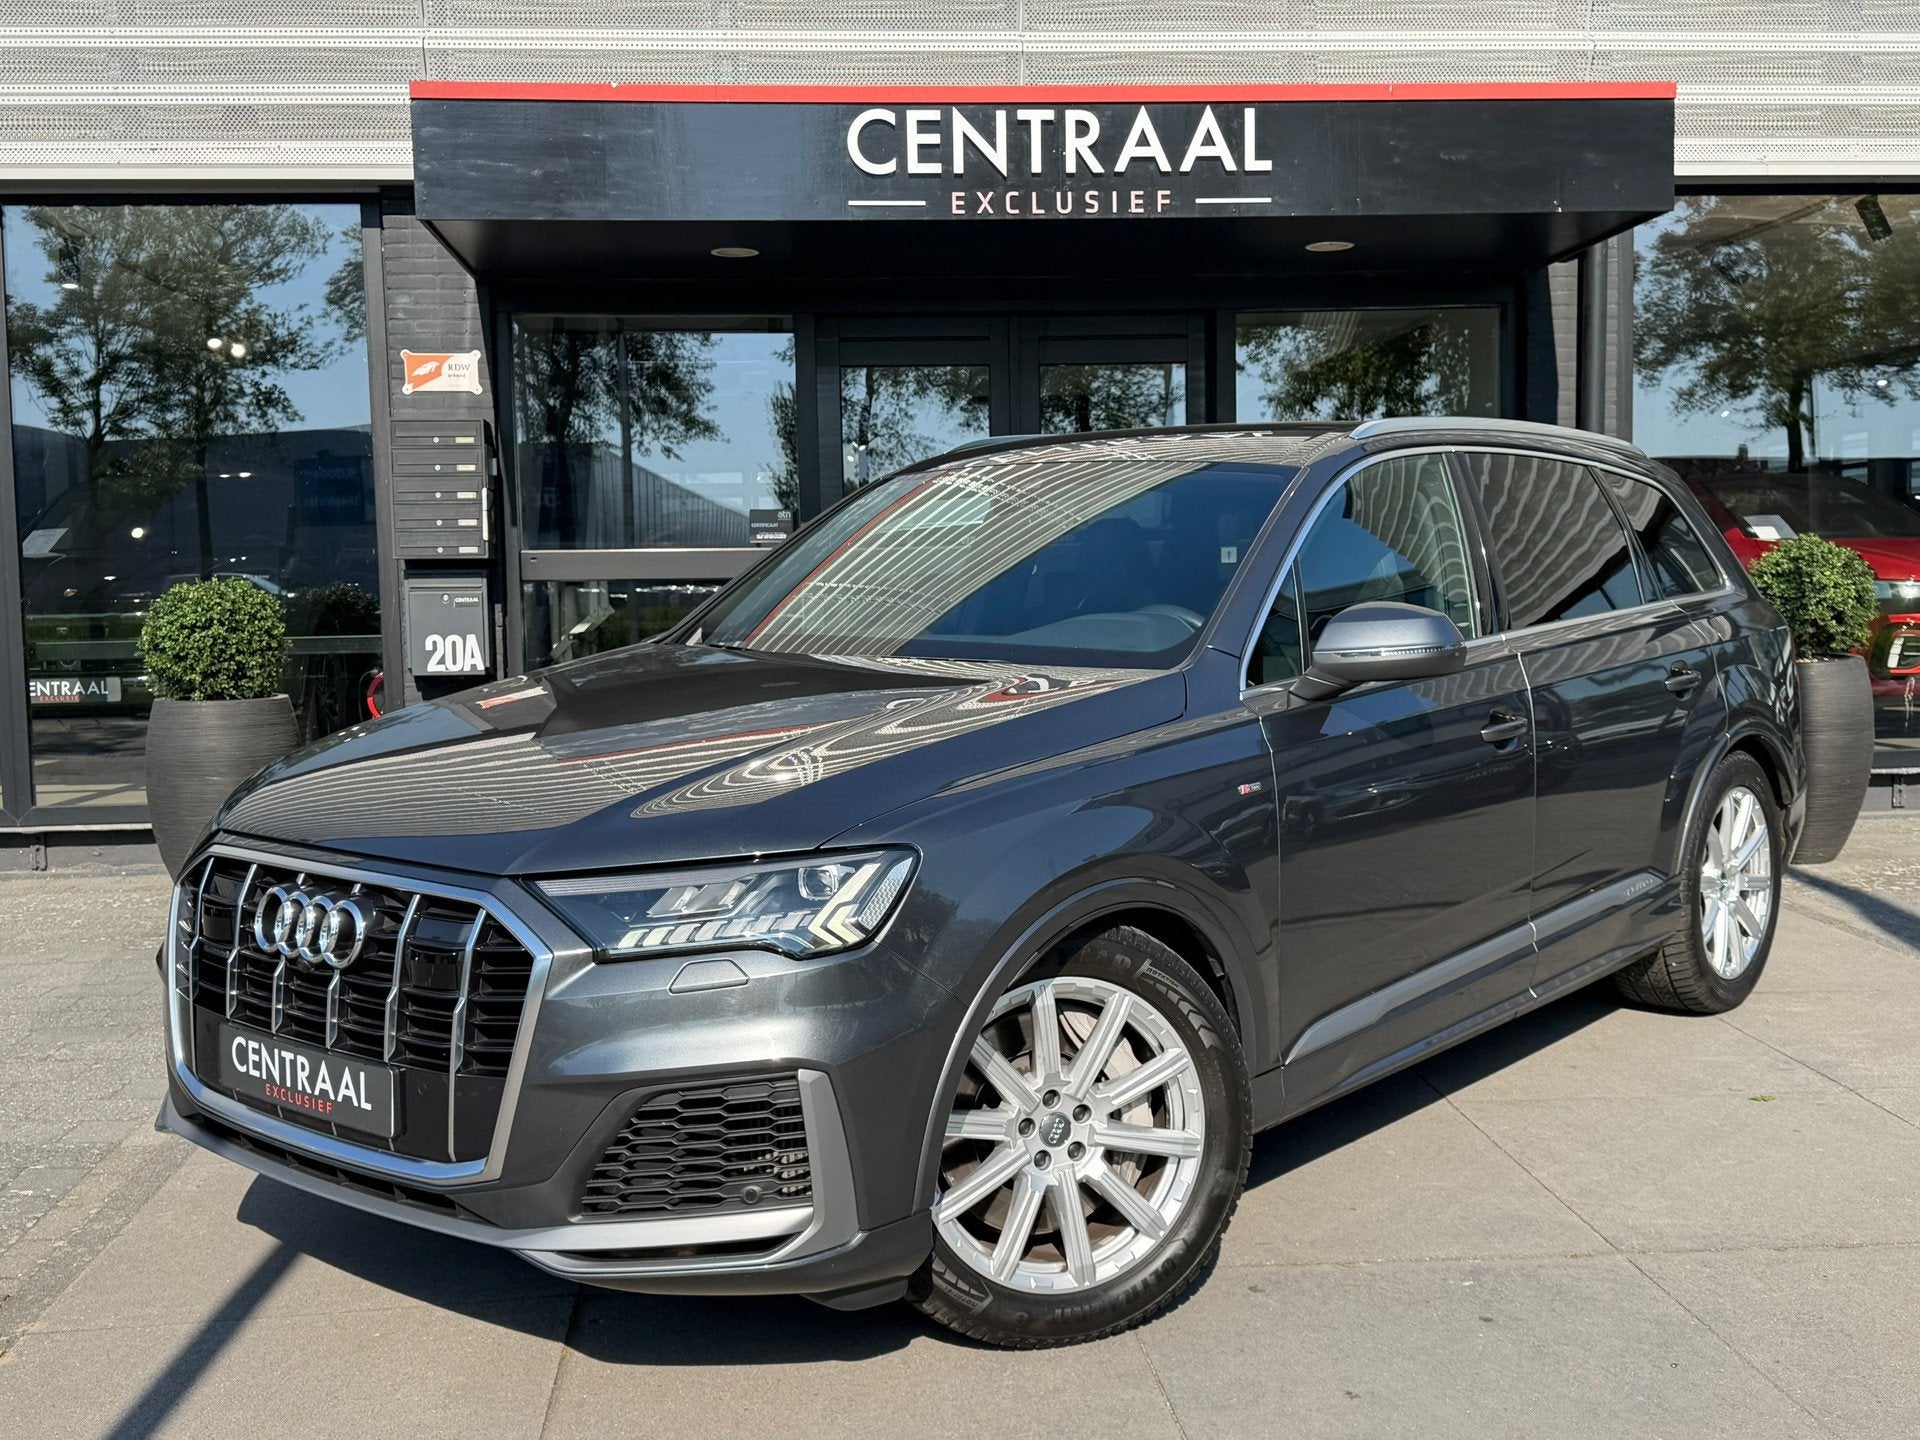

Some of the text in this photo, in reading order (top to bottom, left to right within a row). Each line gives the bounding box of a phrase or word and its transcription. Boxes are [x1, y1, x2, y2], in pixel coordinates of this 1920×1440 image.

[847, 104, 1273, 177] CENTRAAL
[951, 190, 1171, 214] EXCLUSIEF
[447, 363, 471, 372] RDW
[777, 510, 792, 519] atn
[425, 633, 485, 672] 20A
[29, 680, 109, 697] ENTRAAL
[231, 1036, 372, 1111] CENTRAAL
[265, 1083, 334, 1115] EXCLUSIEF
